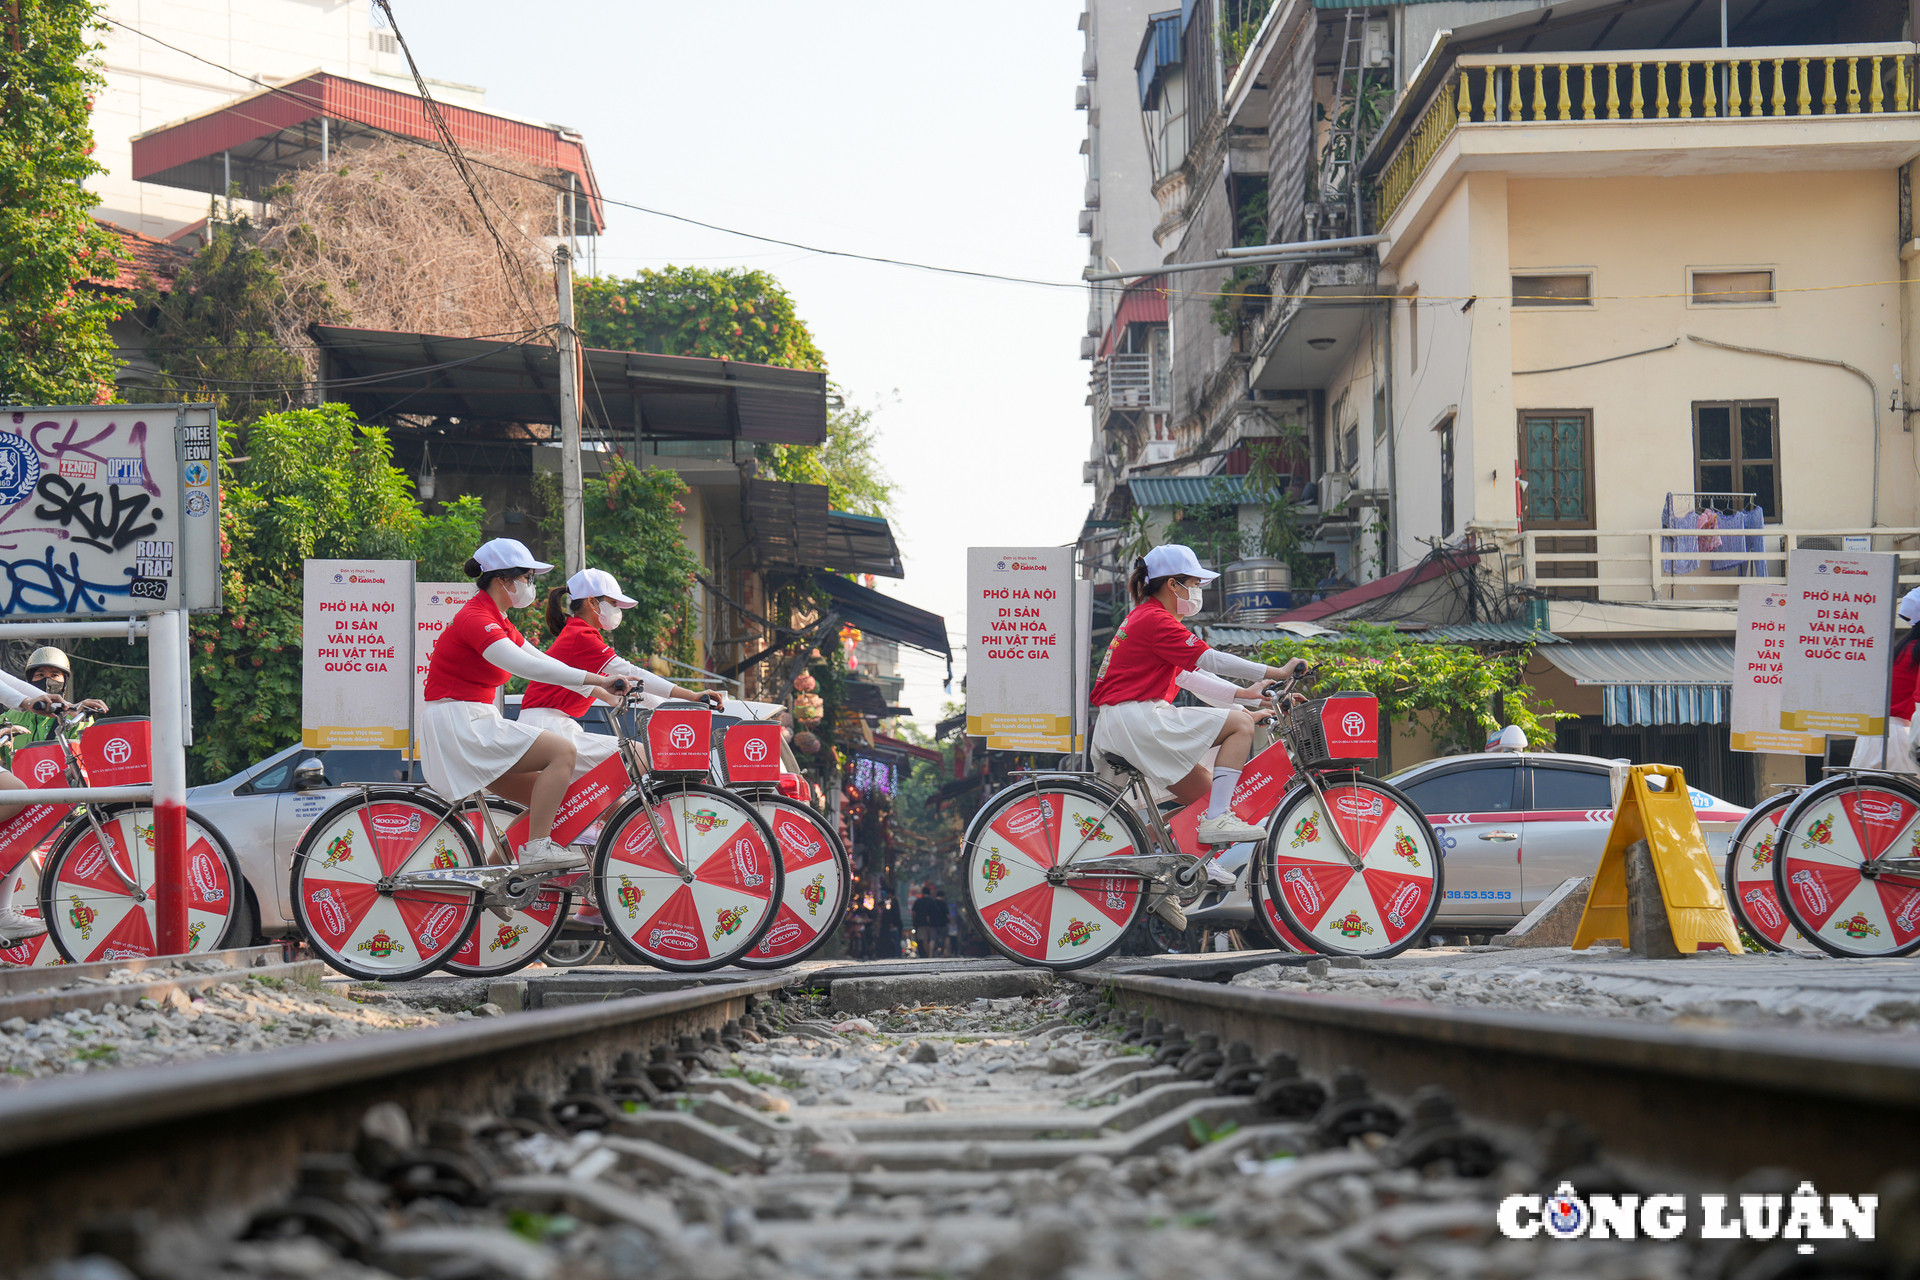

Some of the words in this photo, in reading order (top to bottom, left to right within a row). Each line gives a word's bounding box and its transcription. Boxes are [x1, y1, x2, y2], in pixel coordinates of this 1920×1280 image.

[184, 427, 210, 440] ONEE
[184, 446, 210, 460] EOW
[61, 460, 95, 474] TENDR
[108, 459, 142, 477] OPTIK
[137, 541, 172, 557] ROAD
[136, 560, 172, 576] TRAP
[984, 588, 1009, 598] PHỞ
[1013, 588, 1030, 599] HÀ
[1034, 588, 1056, 601] NỘI
[1804, 590, 1829, 600] PHỞ
[1833, 592, 1850, 601] HÀ
[1855, 593, 1876, 604] NỘI
[320, 600, 346, 611] PHỞ
[351, 601, 368, 611] HÀ
[372, 601, 394, 613] NỘI
[999, 608, 1010, 617] DI
[1015, 606, 1039, 617] SẢN
[1818, 610, 1829, 618] DI
[1834, 609, 1858, 619] SẢN
[336, 621, 347, 629] DI
[352, 619, 377, 630] SẢN
[418, 620, 444, 632] PHỞ
[991, 620, 1016, 630] VĂN
[1021, 621, 1047, 631] HÓA
[1752, 621, 1775, 631] PHỞ
[1810, 622, 1835, 632] VĂN
[1839, 625, 1865, 633] HÓA
[328, 633, 353, 643] VĂN
[358, 633, 385, 644] HÓA
[982, 636, 1001, 644] PHI
[1006, 634, 1029, 646] VẬT
[1032, 633, 1056, 645] THỂ
[1800, 636, 1819, 644] PHI
[1824, 636, 1846, 649] VẬT
[1850, 637, 1873, 647] THỂ
[319, 649, 338, 657] PHI
[343, 647, 365, 660] VẬT
[370, 646, 394, 658] THỂ
[988, 648, 1024, 659] QUỐC
[1028, 650, 1049, 659] GIA
[1758, 650, 1780, 659] VĂN
[1806, 649, 1841, 659] QUỐC
[1845, 652, 1866, 660] GIA
[325, 660, 361, 671] QUỐC
[366, 663, 387, 672] GIA
[1748, 663, 1766, 671] PHI
[1770, 663, 1783, 673] VẬ
[1245, 772, 1262, 786] NAM
[566, 794, 582, 807] VIỆT
[582, 782, 599, 796] NAM
[1232, 790, 1252, 806] ĐỒNG
[1252, 775, 1273, 792] HÀNH
[568, 800, 589, 817] ĐỒNG
[589, 785, 610, 802] HÀNH
[10, 815, 25, 830] VIỆT
[25, 804, 42, 818] NAM
[12, 821, 33, 840] ĐỒNG
[34, 805, 54, 823] HÀNH
[1444, 891, 1511, 899] 38.53.53.53
